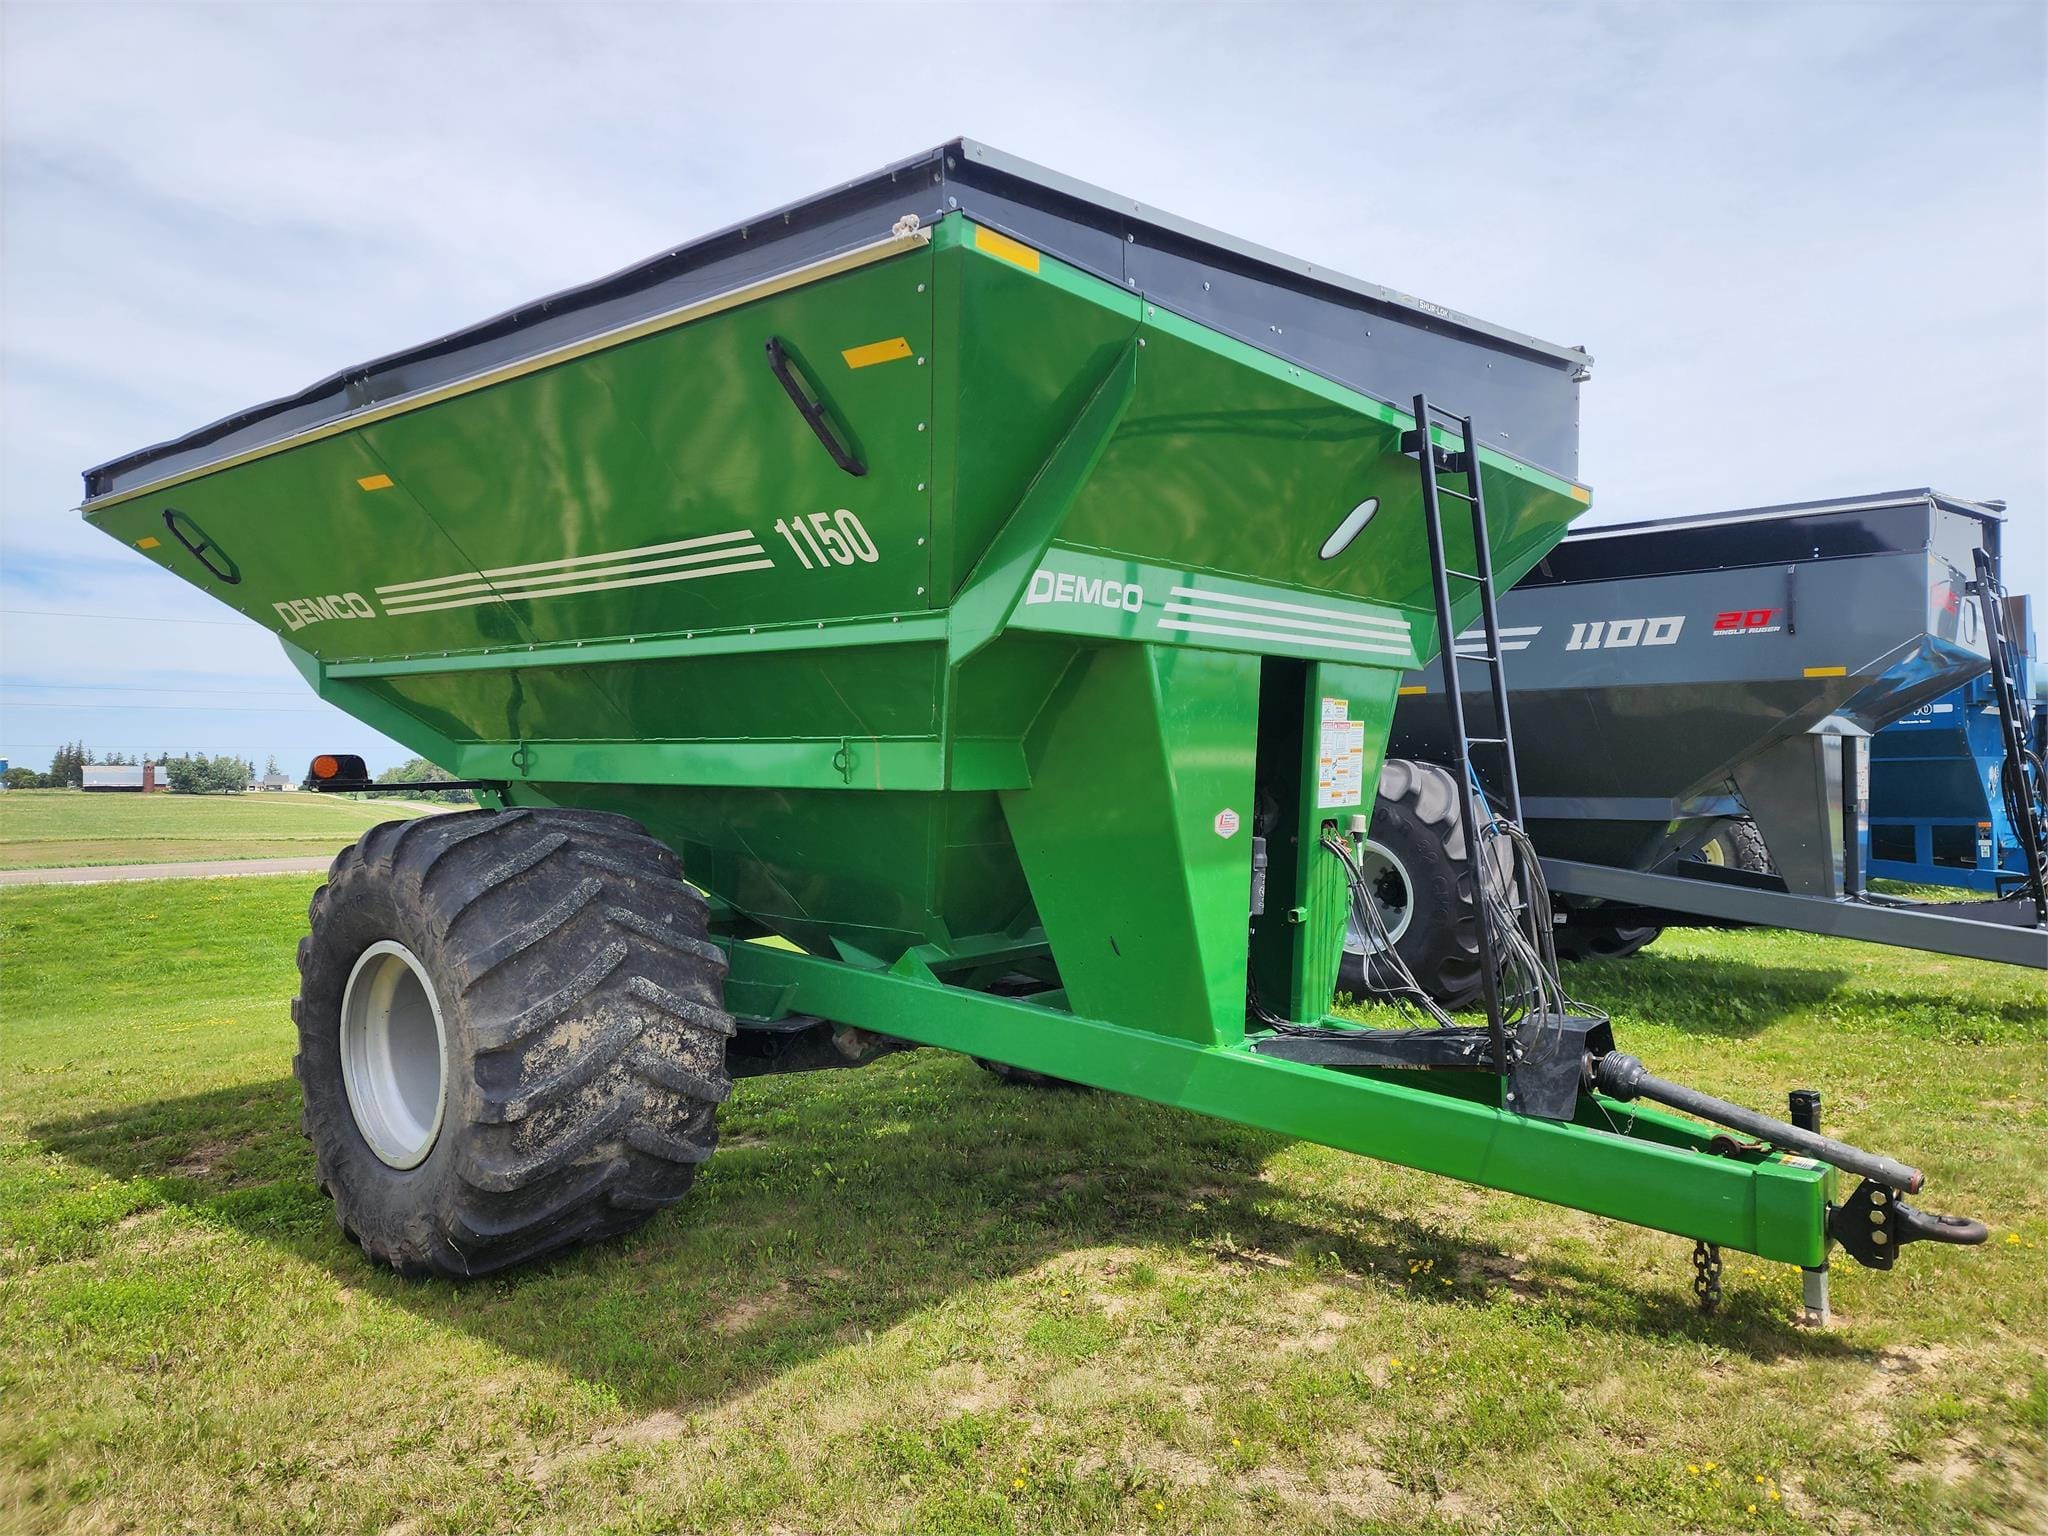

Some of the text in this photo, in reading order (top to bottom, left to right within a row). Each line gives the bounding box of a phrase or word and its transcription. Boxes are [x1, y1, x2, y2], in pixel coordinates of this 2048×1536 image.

[774, 508, 879, 569] 1150
[1025, 569, 1144, 613] DEMCO
[271, 592, 376, 631] DEMCO
[1712, 626, 1781, 636] SINGLE AUGER
[1565, 616, 1686, 651] 1100
